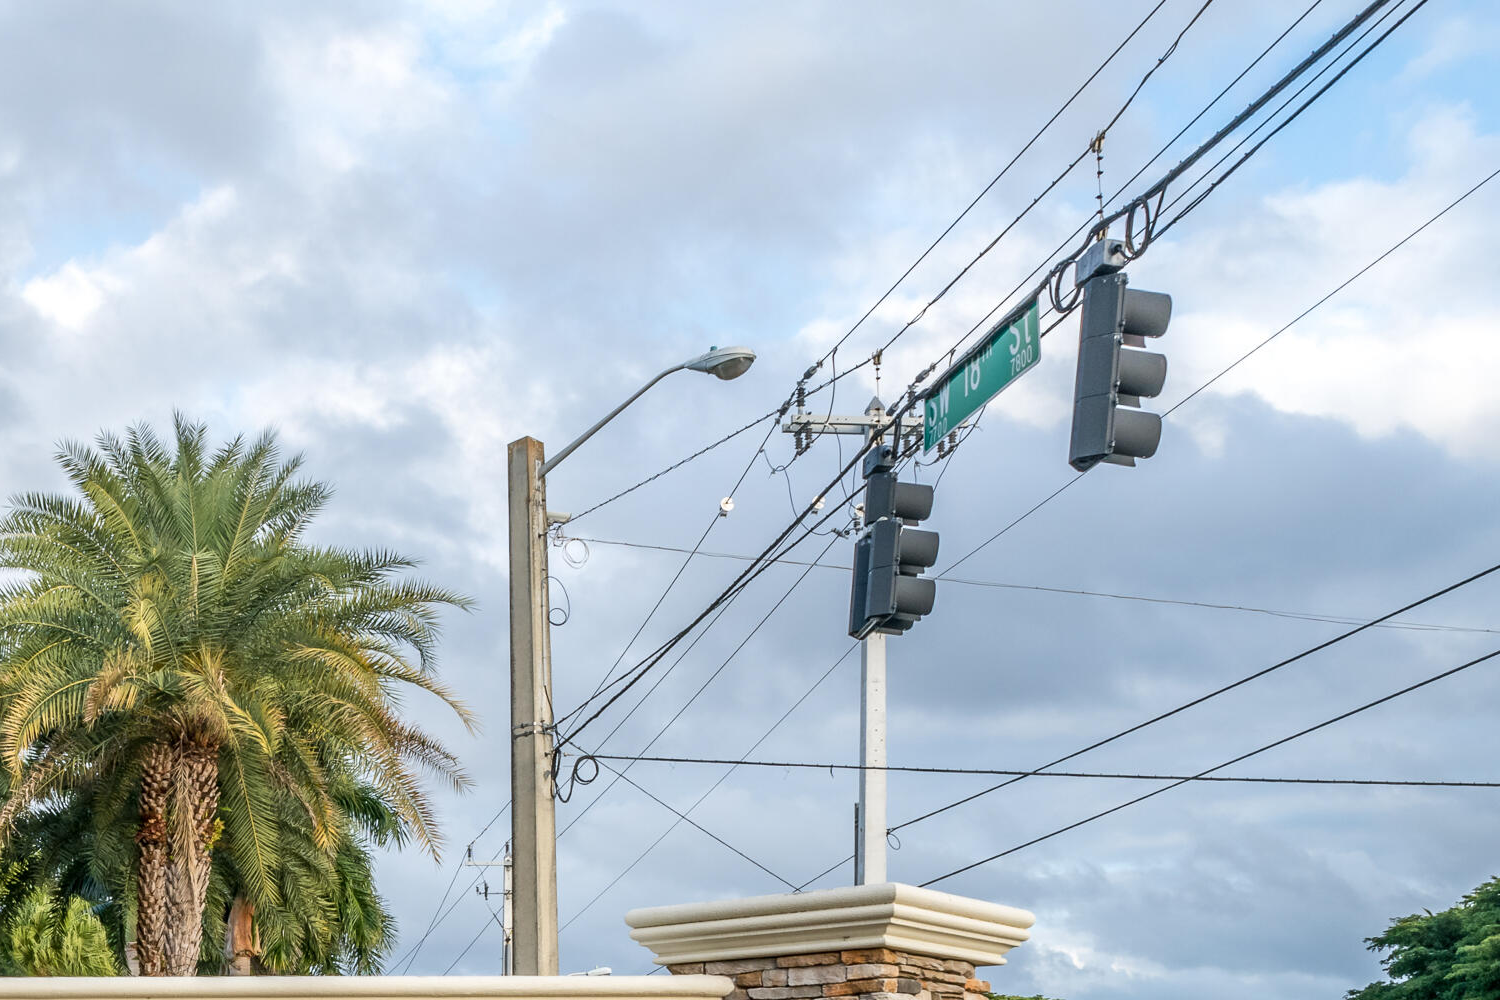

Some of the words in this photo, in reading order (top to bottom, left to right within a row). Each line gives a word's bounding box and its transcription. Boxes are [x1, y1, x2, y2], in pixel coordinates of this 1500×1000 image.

[1010, 345, 1033, 376] 7800
[928, 378, 950, 427] SW
[929, 418, 948, 446] 7700
